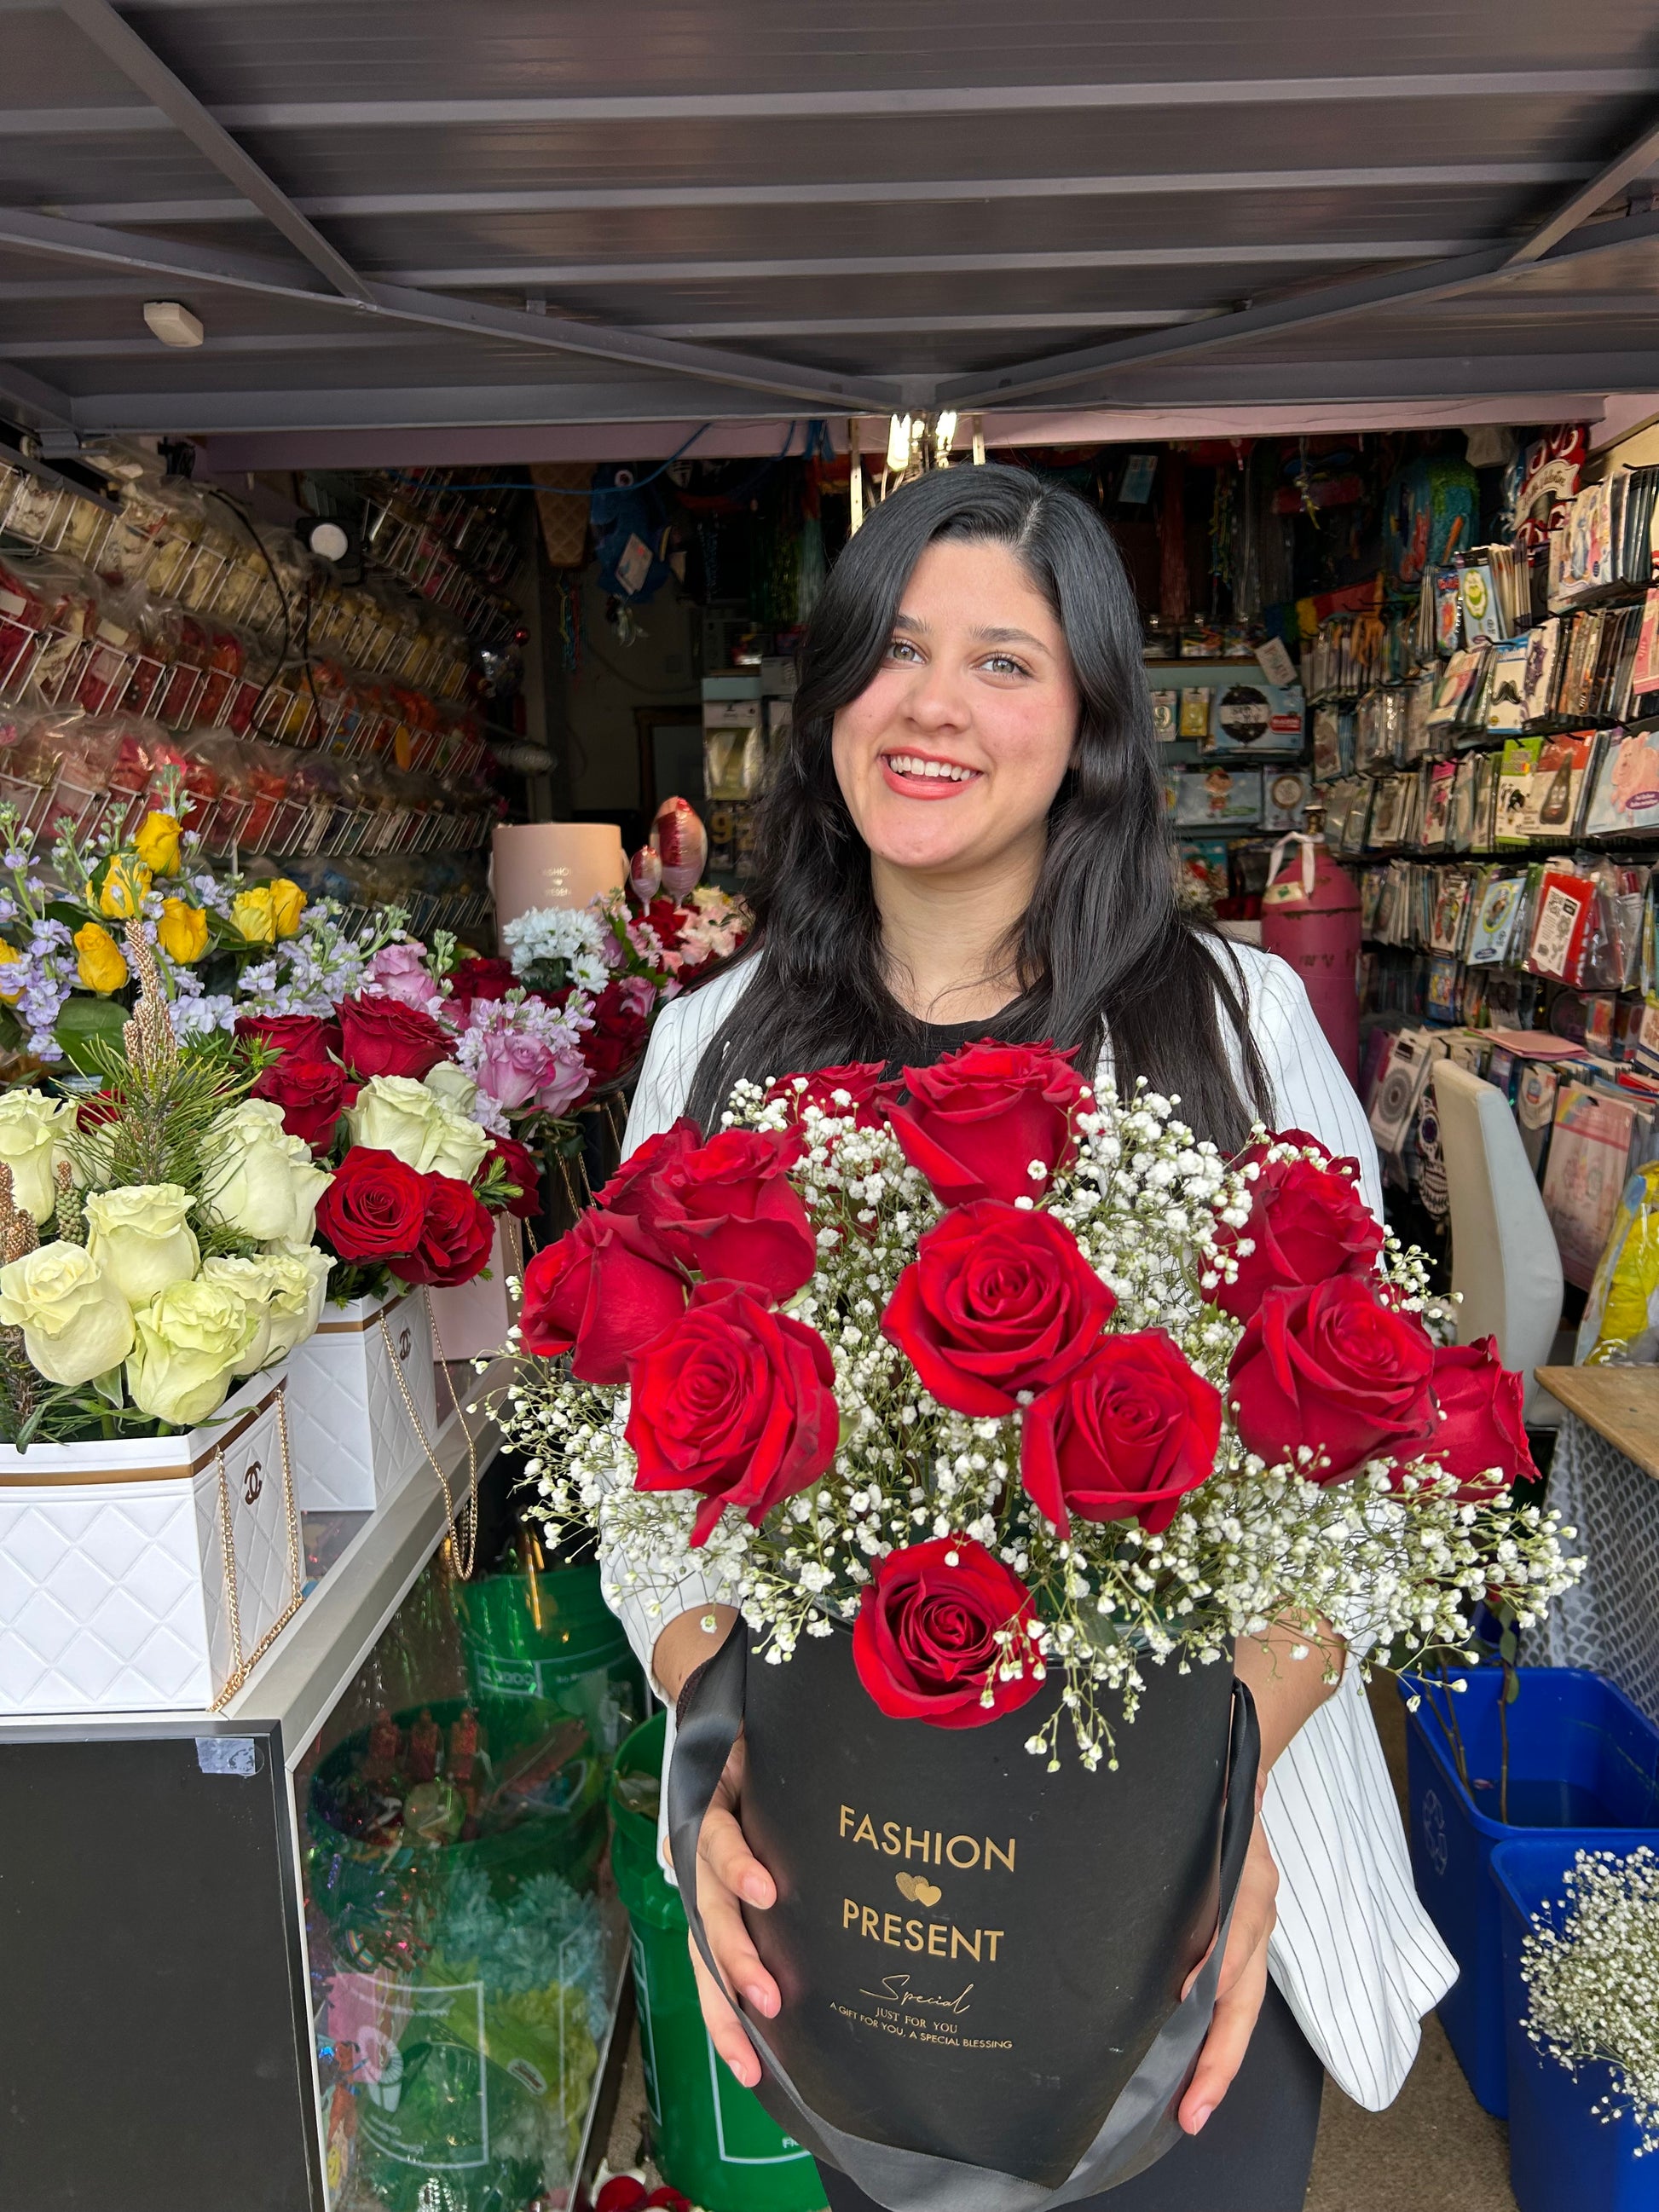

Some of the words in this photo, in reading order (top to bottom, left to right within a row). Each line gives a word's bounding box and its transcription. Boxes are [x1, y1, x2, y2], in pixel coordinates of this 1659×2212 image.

[840, 1804, 1015, 1873] FASHION
[842, 1897, 1004, 1962] PRESENT
[859, 1974, 974, 2014] Special
[830, 2001, 837, 2010] A
[838, 2006, 858, 2019] GIFT
[860, 2014, 878, 2028] FOR
[881, 2021, 905, 2037] YOU,
[909, 2030, 918, 2039] A
[921, 2032, 960, 2046] SPECIAL
[962, 2038, 1013, 2049] BLESSING
[875, 2007, 899, 2022] JUST
[905, 2015, 927, 2029] FOR
[933, 2021, 957, 2034] YOU
